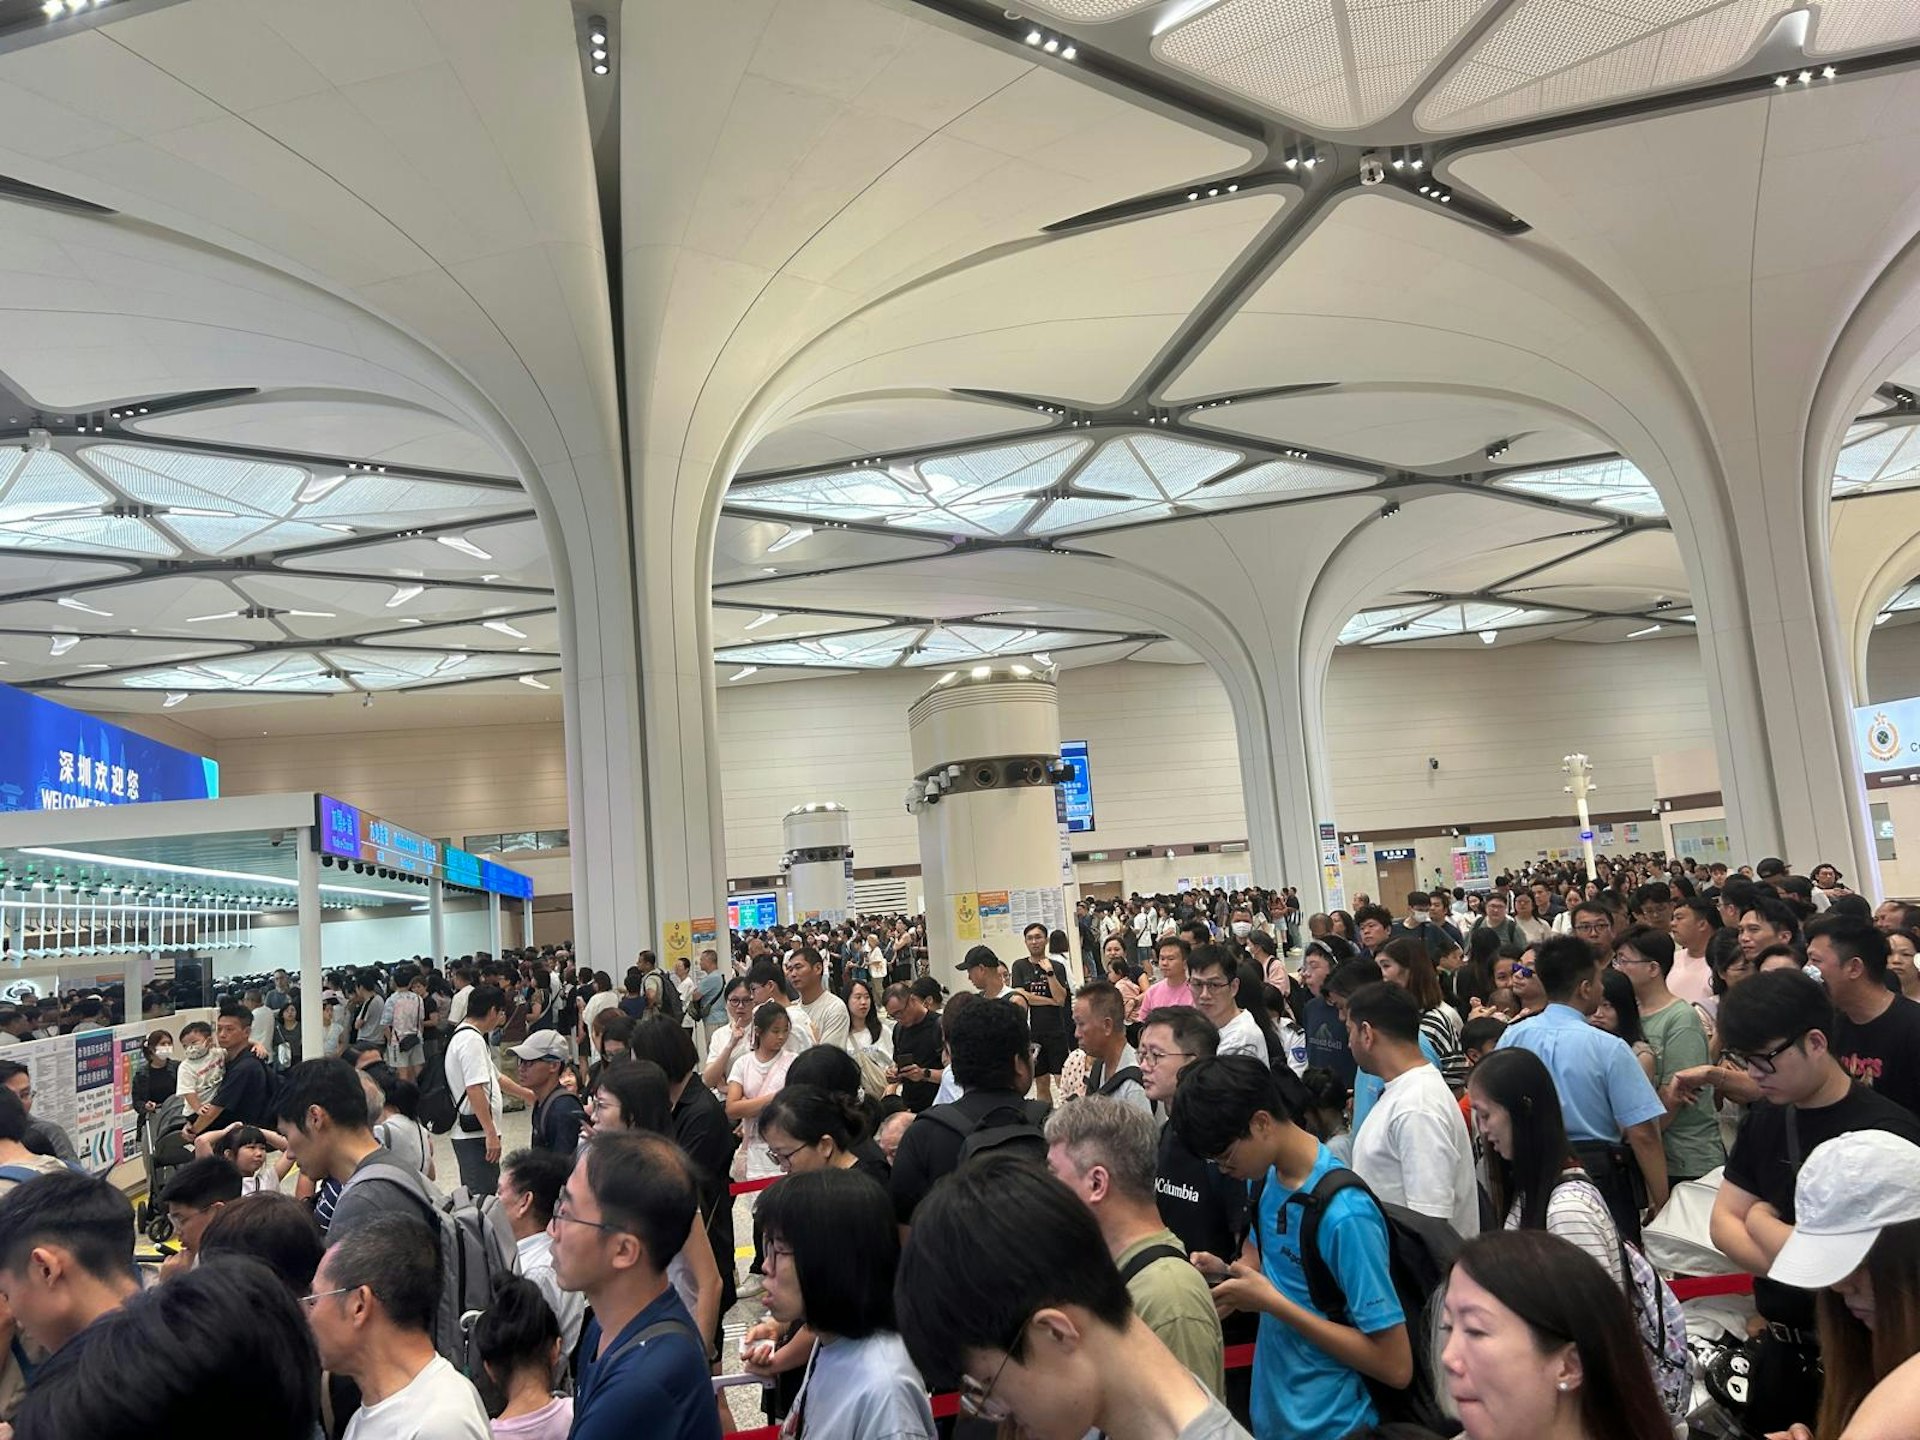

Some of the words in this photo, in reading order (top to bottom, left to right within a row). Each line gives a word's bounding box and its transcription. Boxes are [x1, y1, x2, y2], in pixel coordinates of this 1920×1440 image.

[59, 750, 139, 800] 深圳欢迎您
[1157, 1177, 1199, 1202] Columbia
